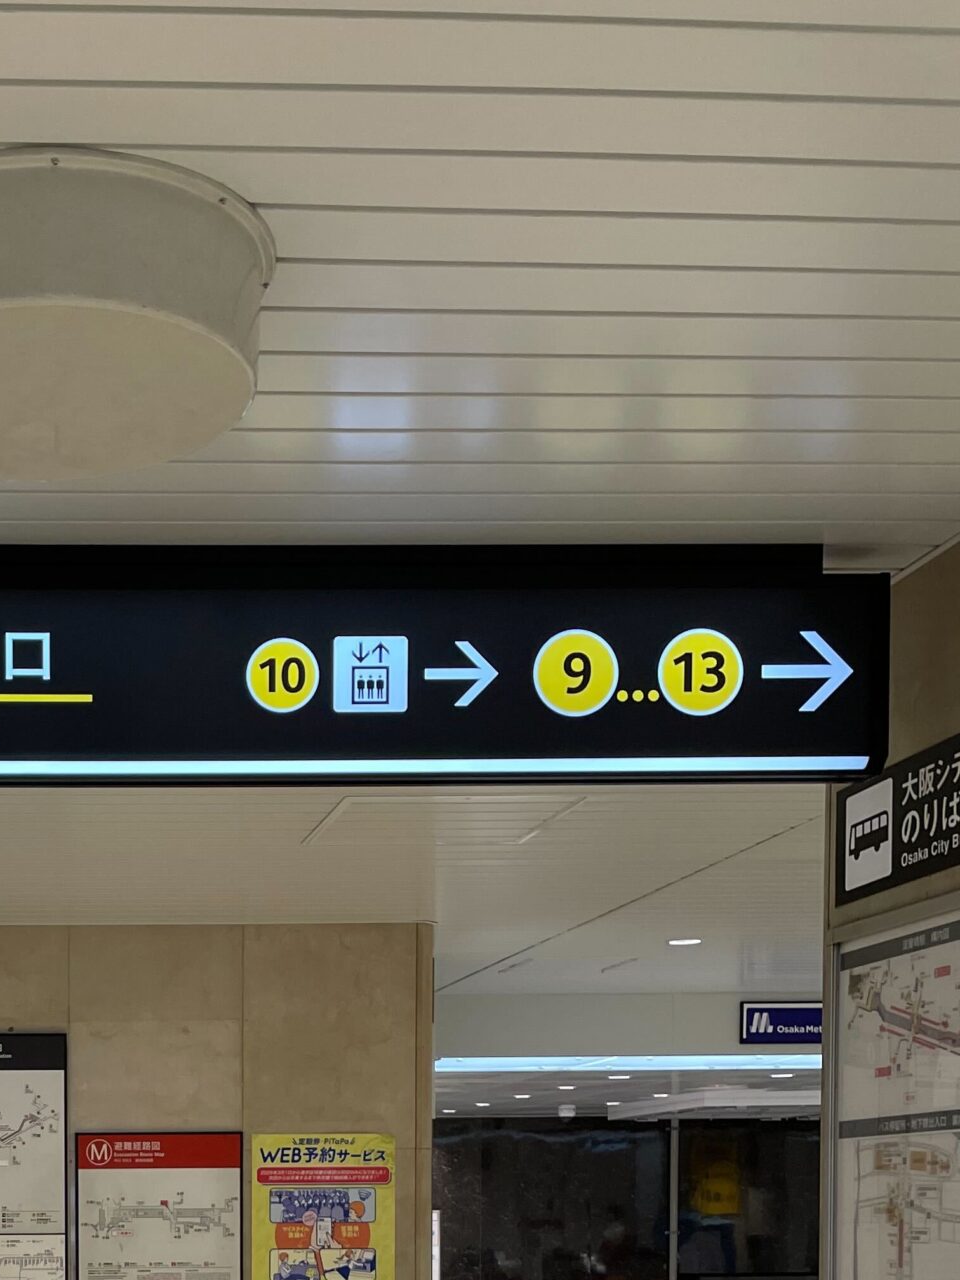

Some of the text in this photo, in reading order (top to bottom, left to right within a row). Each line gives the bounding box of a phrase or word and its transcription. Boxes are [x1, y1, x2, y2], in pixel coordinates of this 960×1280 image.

[259, 656, 306, 695] 10
[562, 652, 592, 694] 9
[673, 651, 726, 693] 13
[901, 848, 929, 868] Osaka
[931, 840, 949, 860] City
[777, 1025, 804, 1033] Osaka
[260, 1147, 386, 1163] WEB予約サービス
